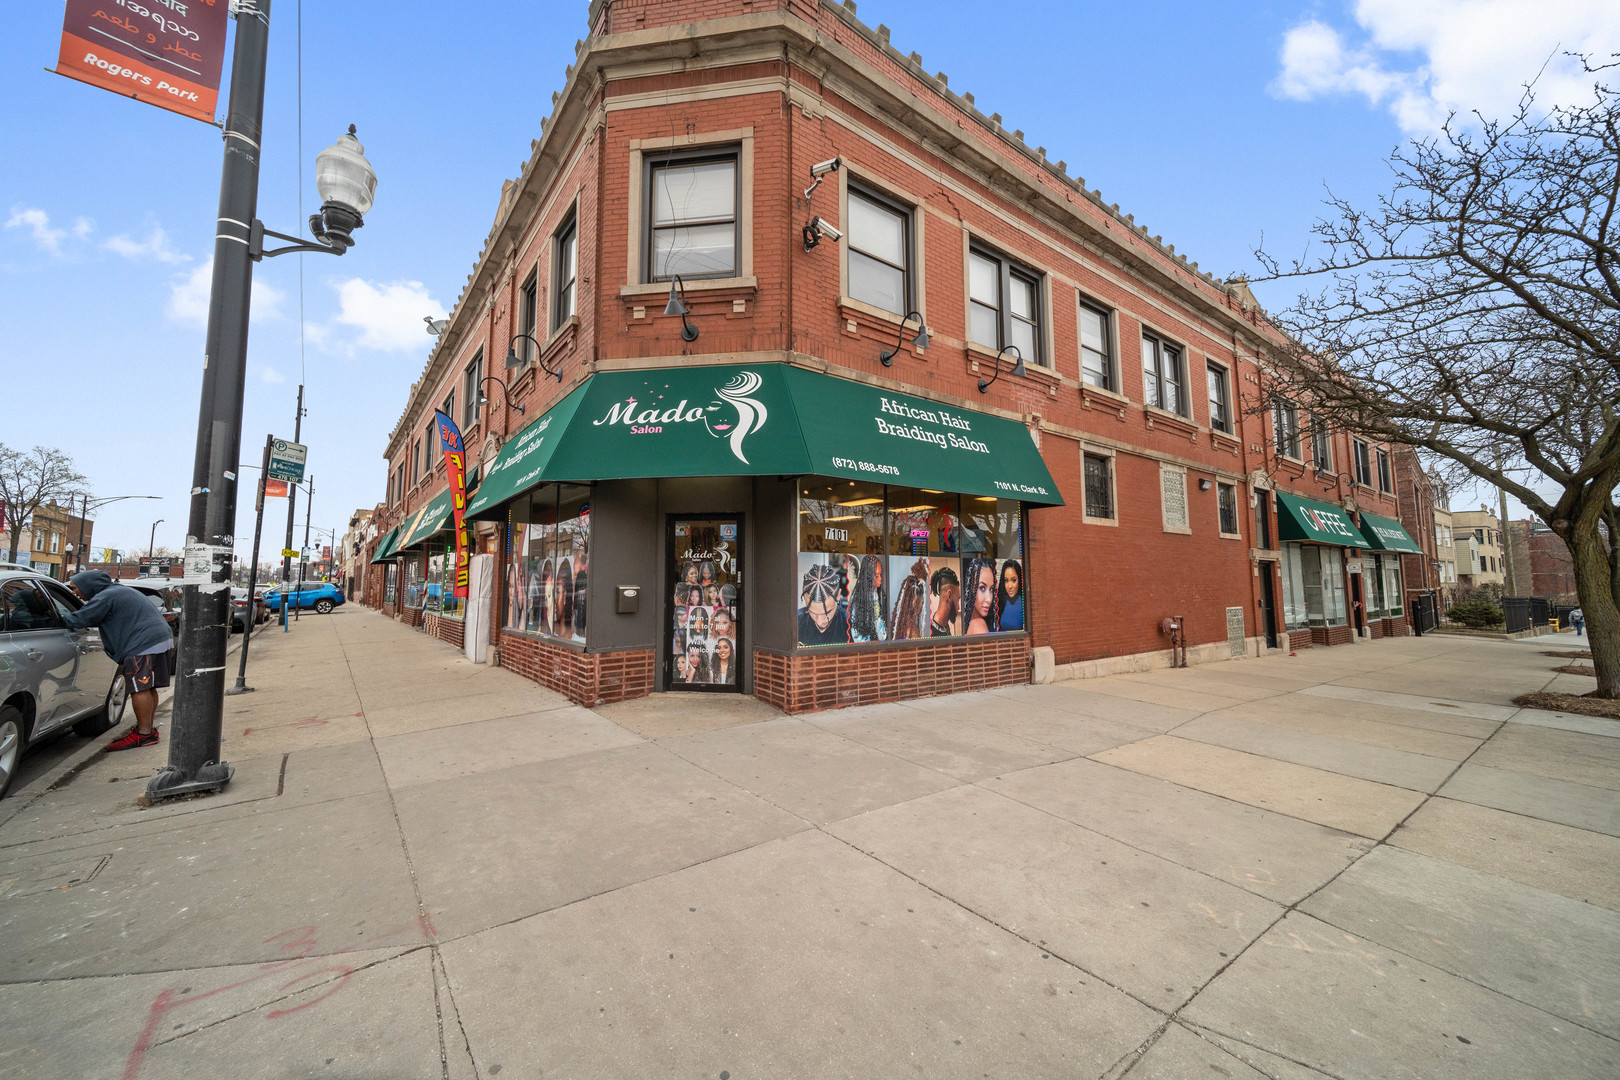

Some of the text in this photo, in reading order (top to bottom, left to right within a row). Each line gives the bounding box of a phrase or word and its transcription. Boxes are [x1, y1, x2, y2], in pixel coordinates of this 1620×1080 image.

[84, 53, 198, 102] Rogers Park
[593, 400, 703, 426] Mado
[881, 397, 971, 431] African Hair
[630, 424, 663, 435] Salon
[875, 417, 990, 454] Braiding Salon
[832, 457, 900, 475] (872) 888-5678
[994, 481, 1012, 490] 7101
[1020, 484, 1039, 494] Clark
[825, 528, 848, 541] 7101
[910, 530, 930, 538] OPEN
[680, 549, 713, 559] Mado
